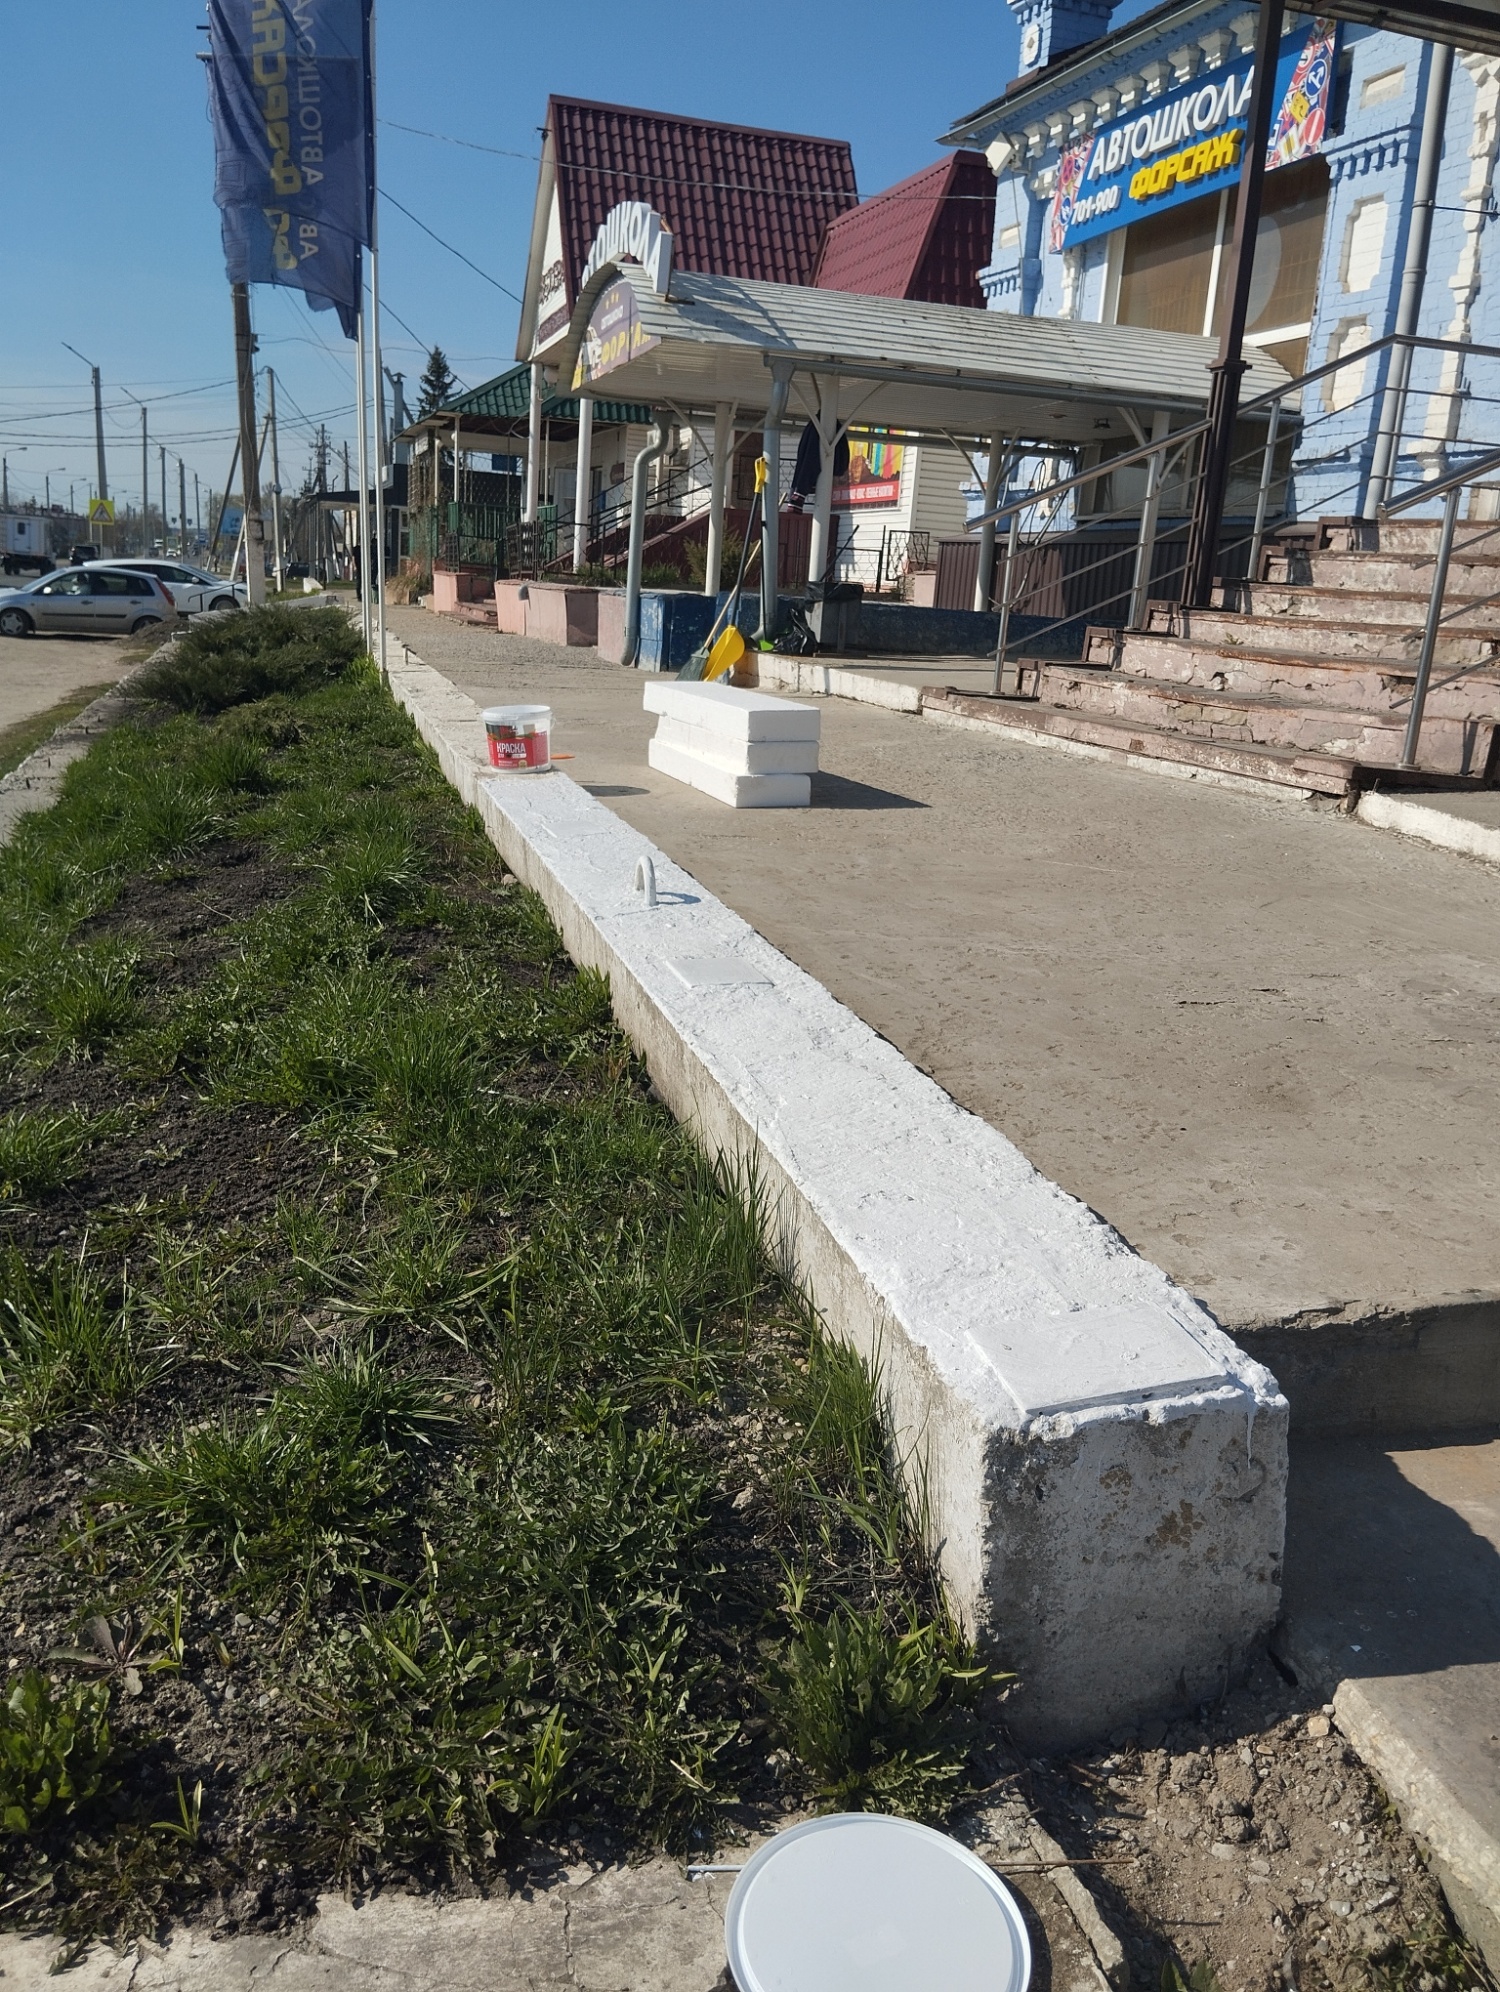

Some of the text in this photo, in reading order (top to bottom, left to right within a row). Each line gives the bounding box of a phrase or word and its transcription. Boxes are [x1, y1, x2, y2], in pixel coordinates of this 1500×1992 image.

[1087, 65, 1255, 181] АВТОШКОЛА
[1129, 128, 1240, 200] ФОРСАЖ
[1071, 185, 1119, 226] 701-900
[496, 742, 526, 753] КРАСКА
